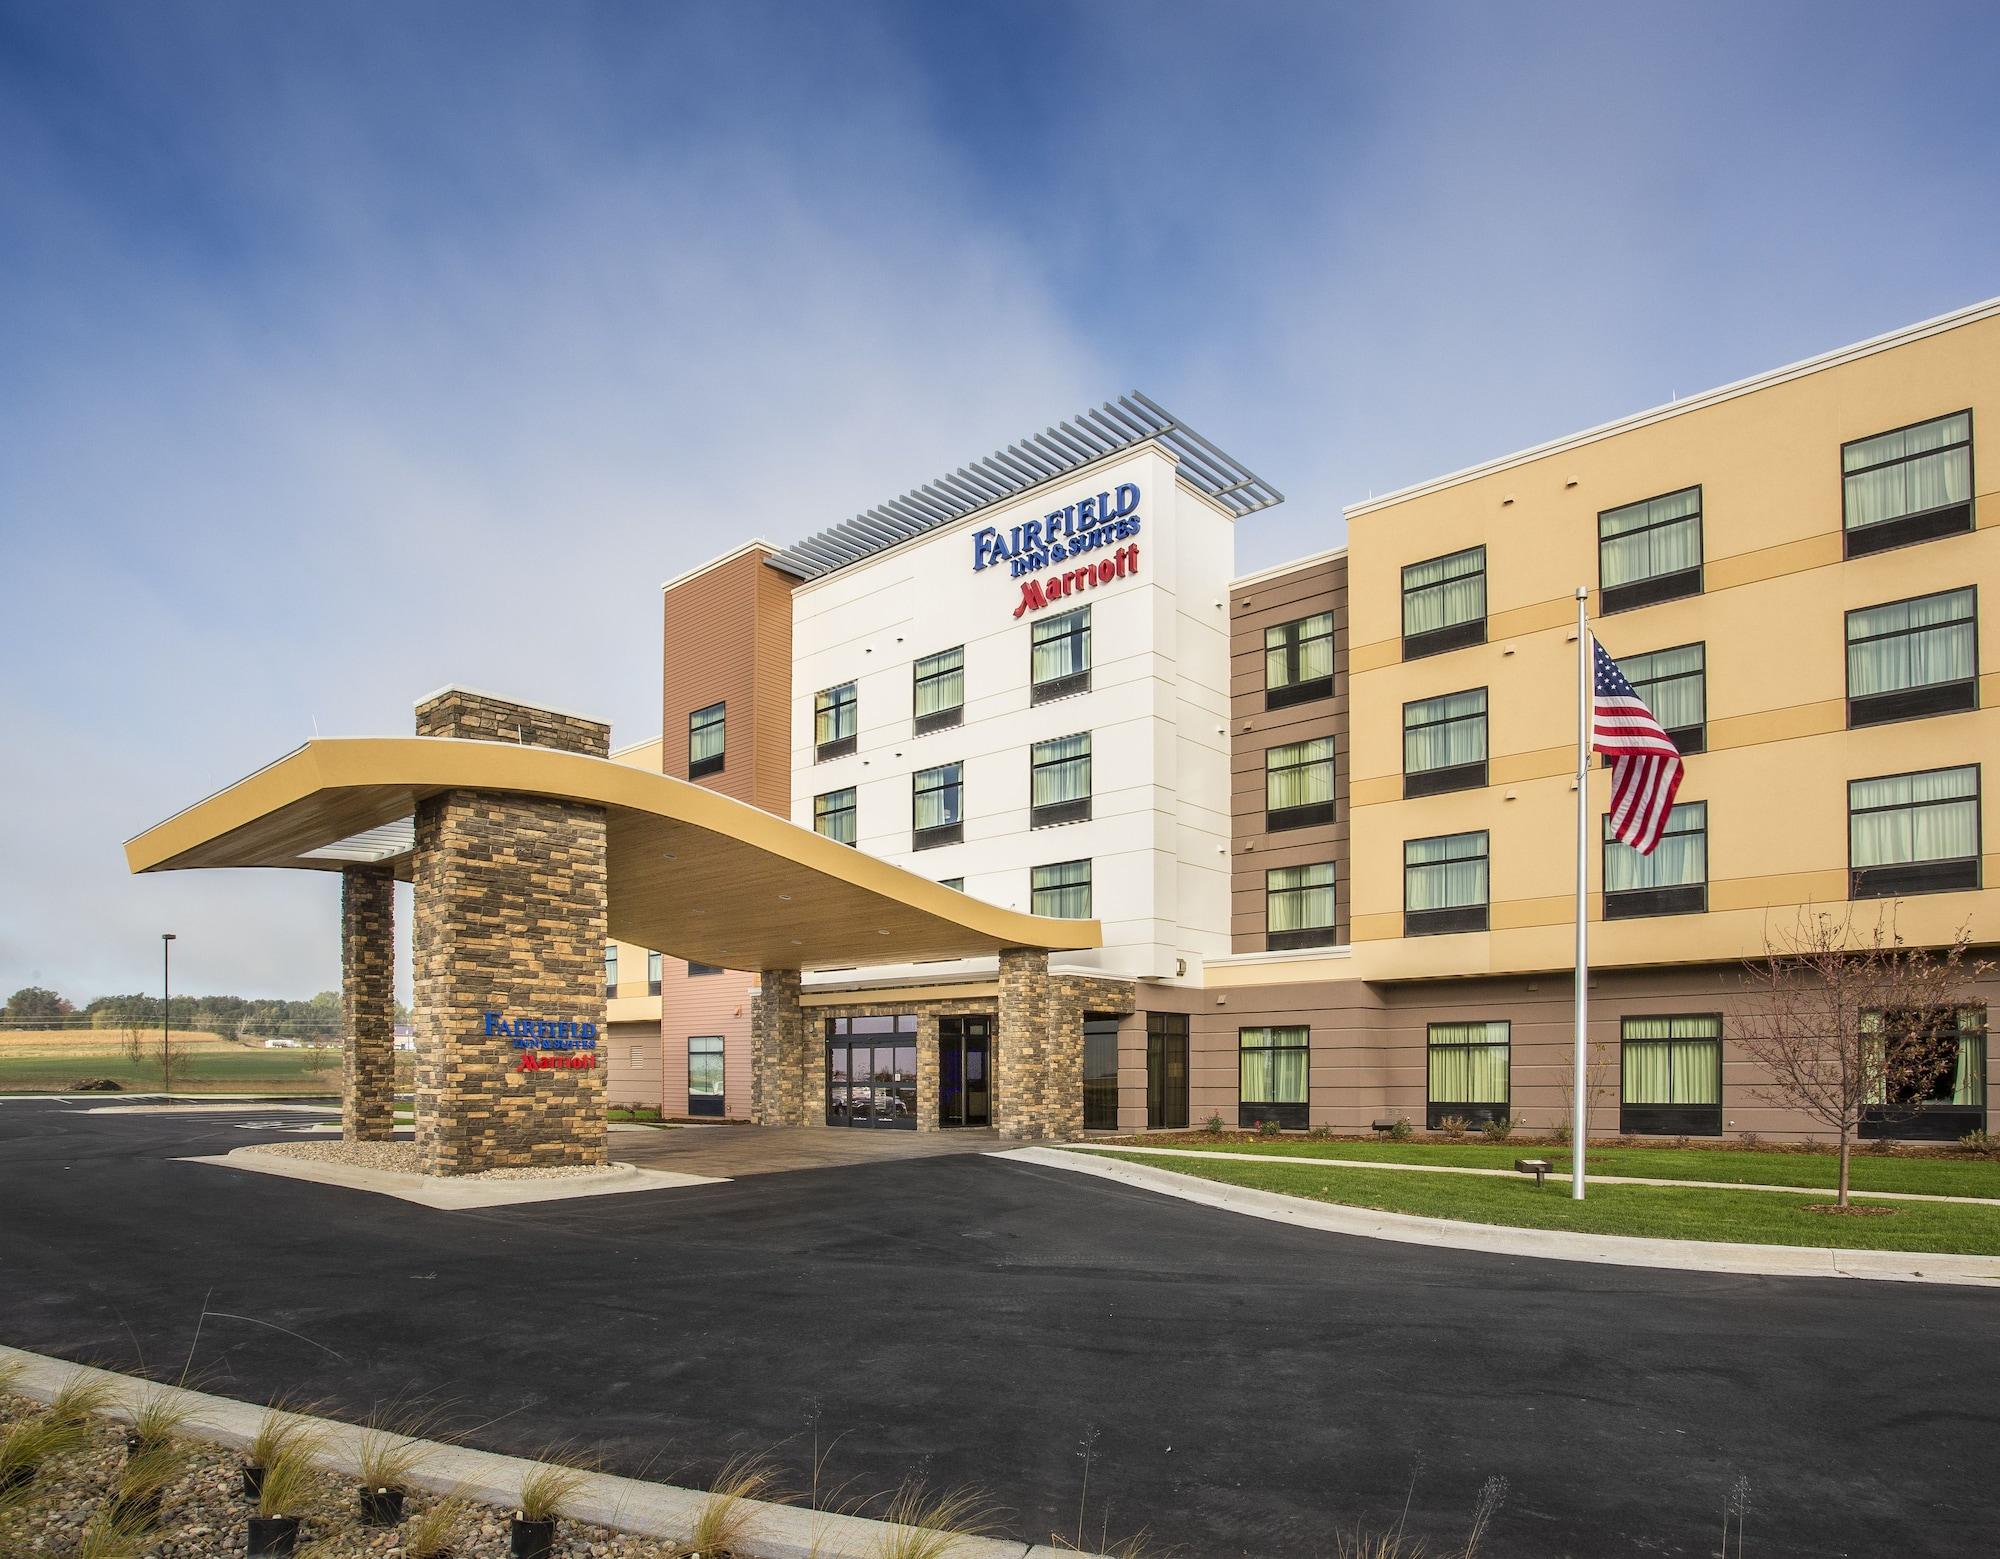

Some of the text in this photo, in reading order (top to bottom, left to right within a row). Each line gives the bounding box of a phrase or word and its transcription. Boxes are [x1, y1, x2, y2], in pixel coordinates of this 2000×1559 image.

[972, 483, 1141, 571] FAIRFIELD
[1010, 547, 1050, 577] INN
[1068, 515, 1141, 556] SUITES
[1013, 543, 1139, 618] Marriott
[483, 1011, 597, 1039] FAIRFIELD
[516, 1054, 597, 1073] Marriott
